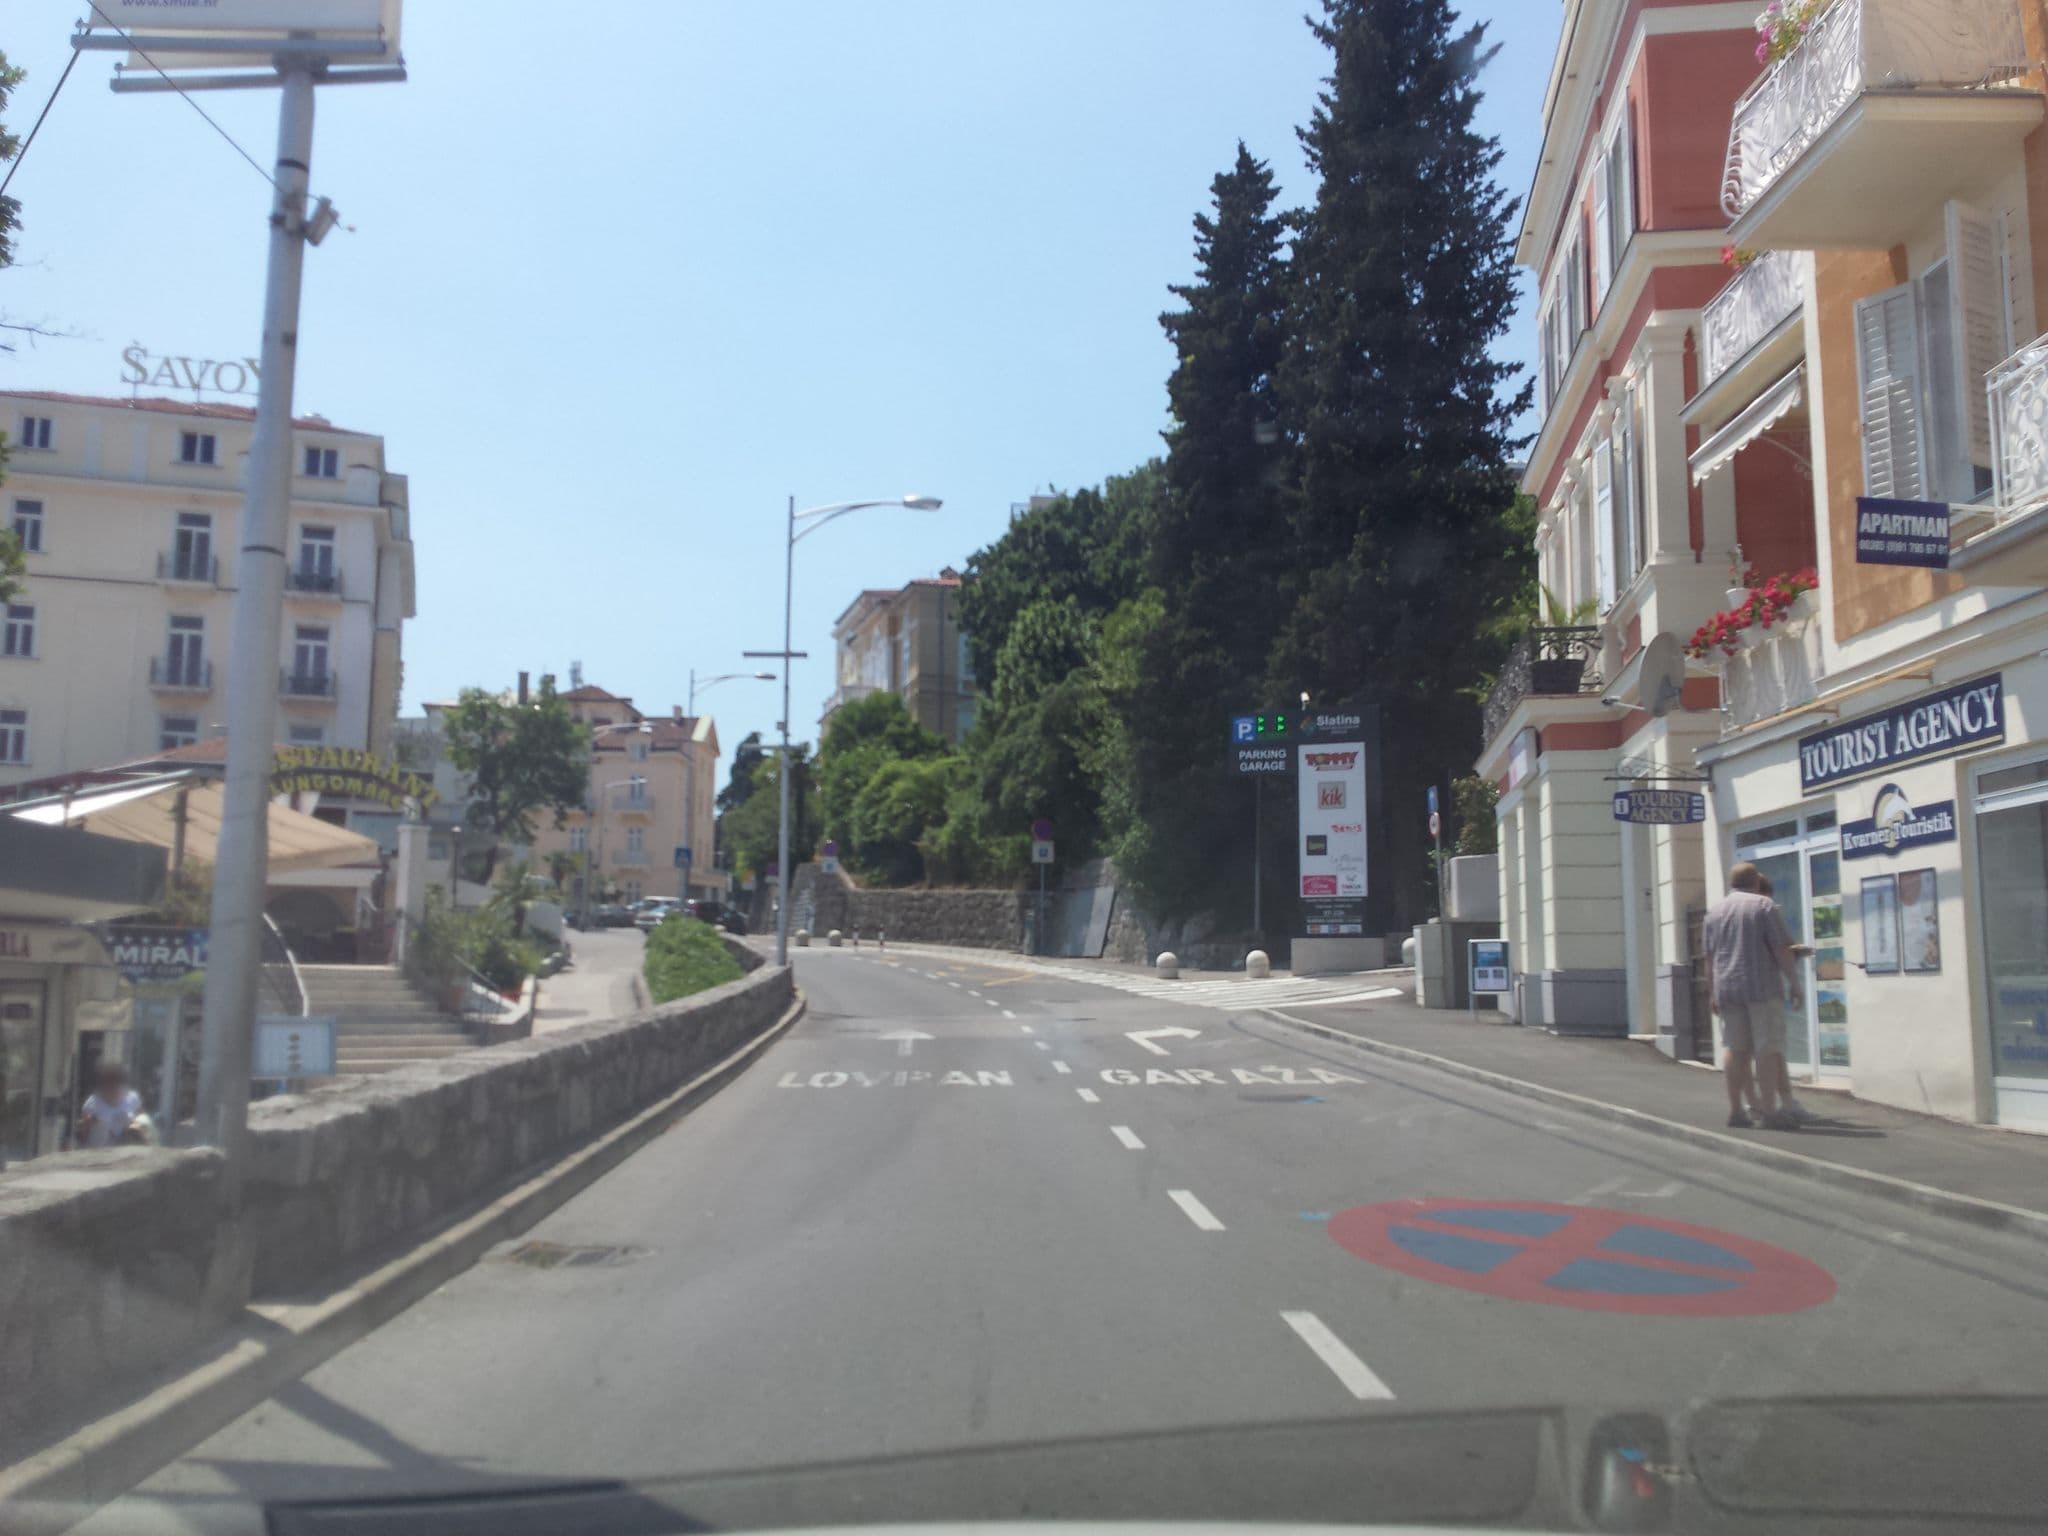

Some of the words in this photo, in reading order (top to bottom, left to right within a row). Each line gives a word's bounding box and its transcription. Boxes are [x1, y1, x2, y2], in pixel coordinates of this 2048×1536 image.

[1860, 512, 1948, 538] APARTMAN
[1316, 713, 1360, 727] Slatina
[1802, 720, 1890, 781] TOURIST
[1894, 683, 2000, 755] AGENCY
[1239, 748, 1287, 760] PARKING
[1240, 760, 1286, 772] GARAGE
[1629, 791, 1690, 807] TOURIST
[1631, 807, 1688, 822] AGENCY
